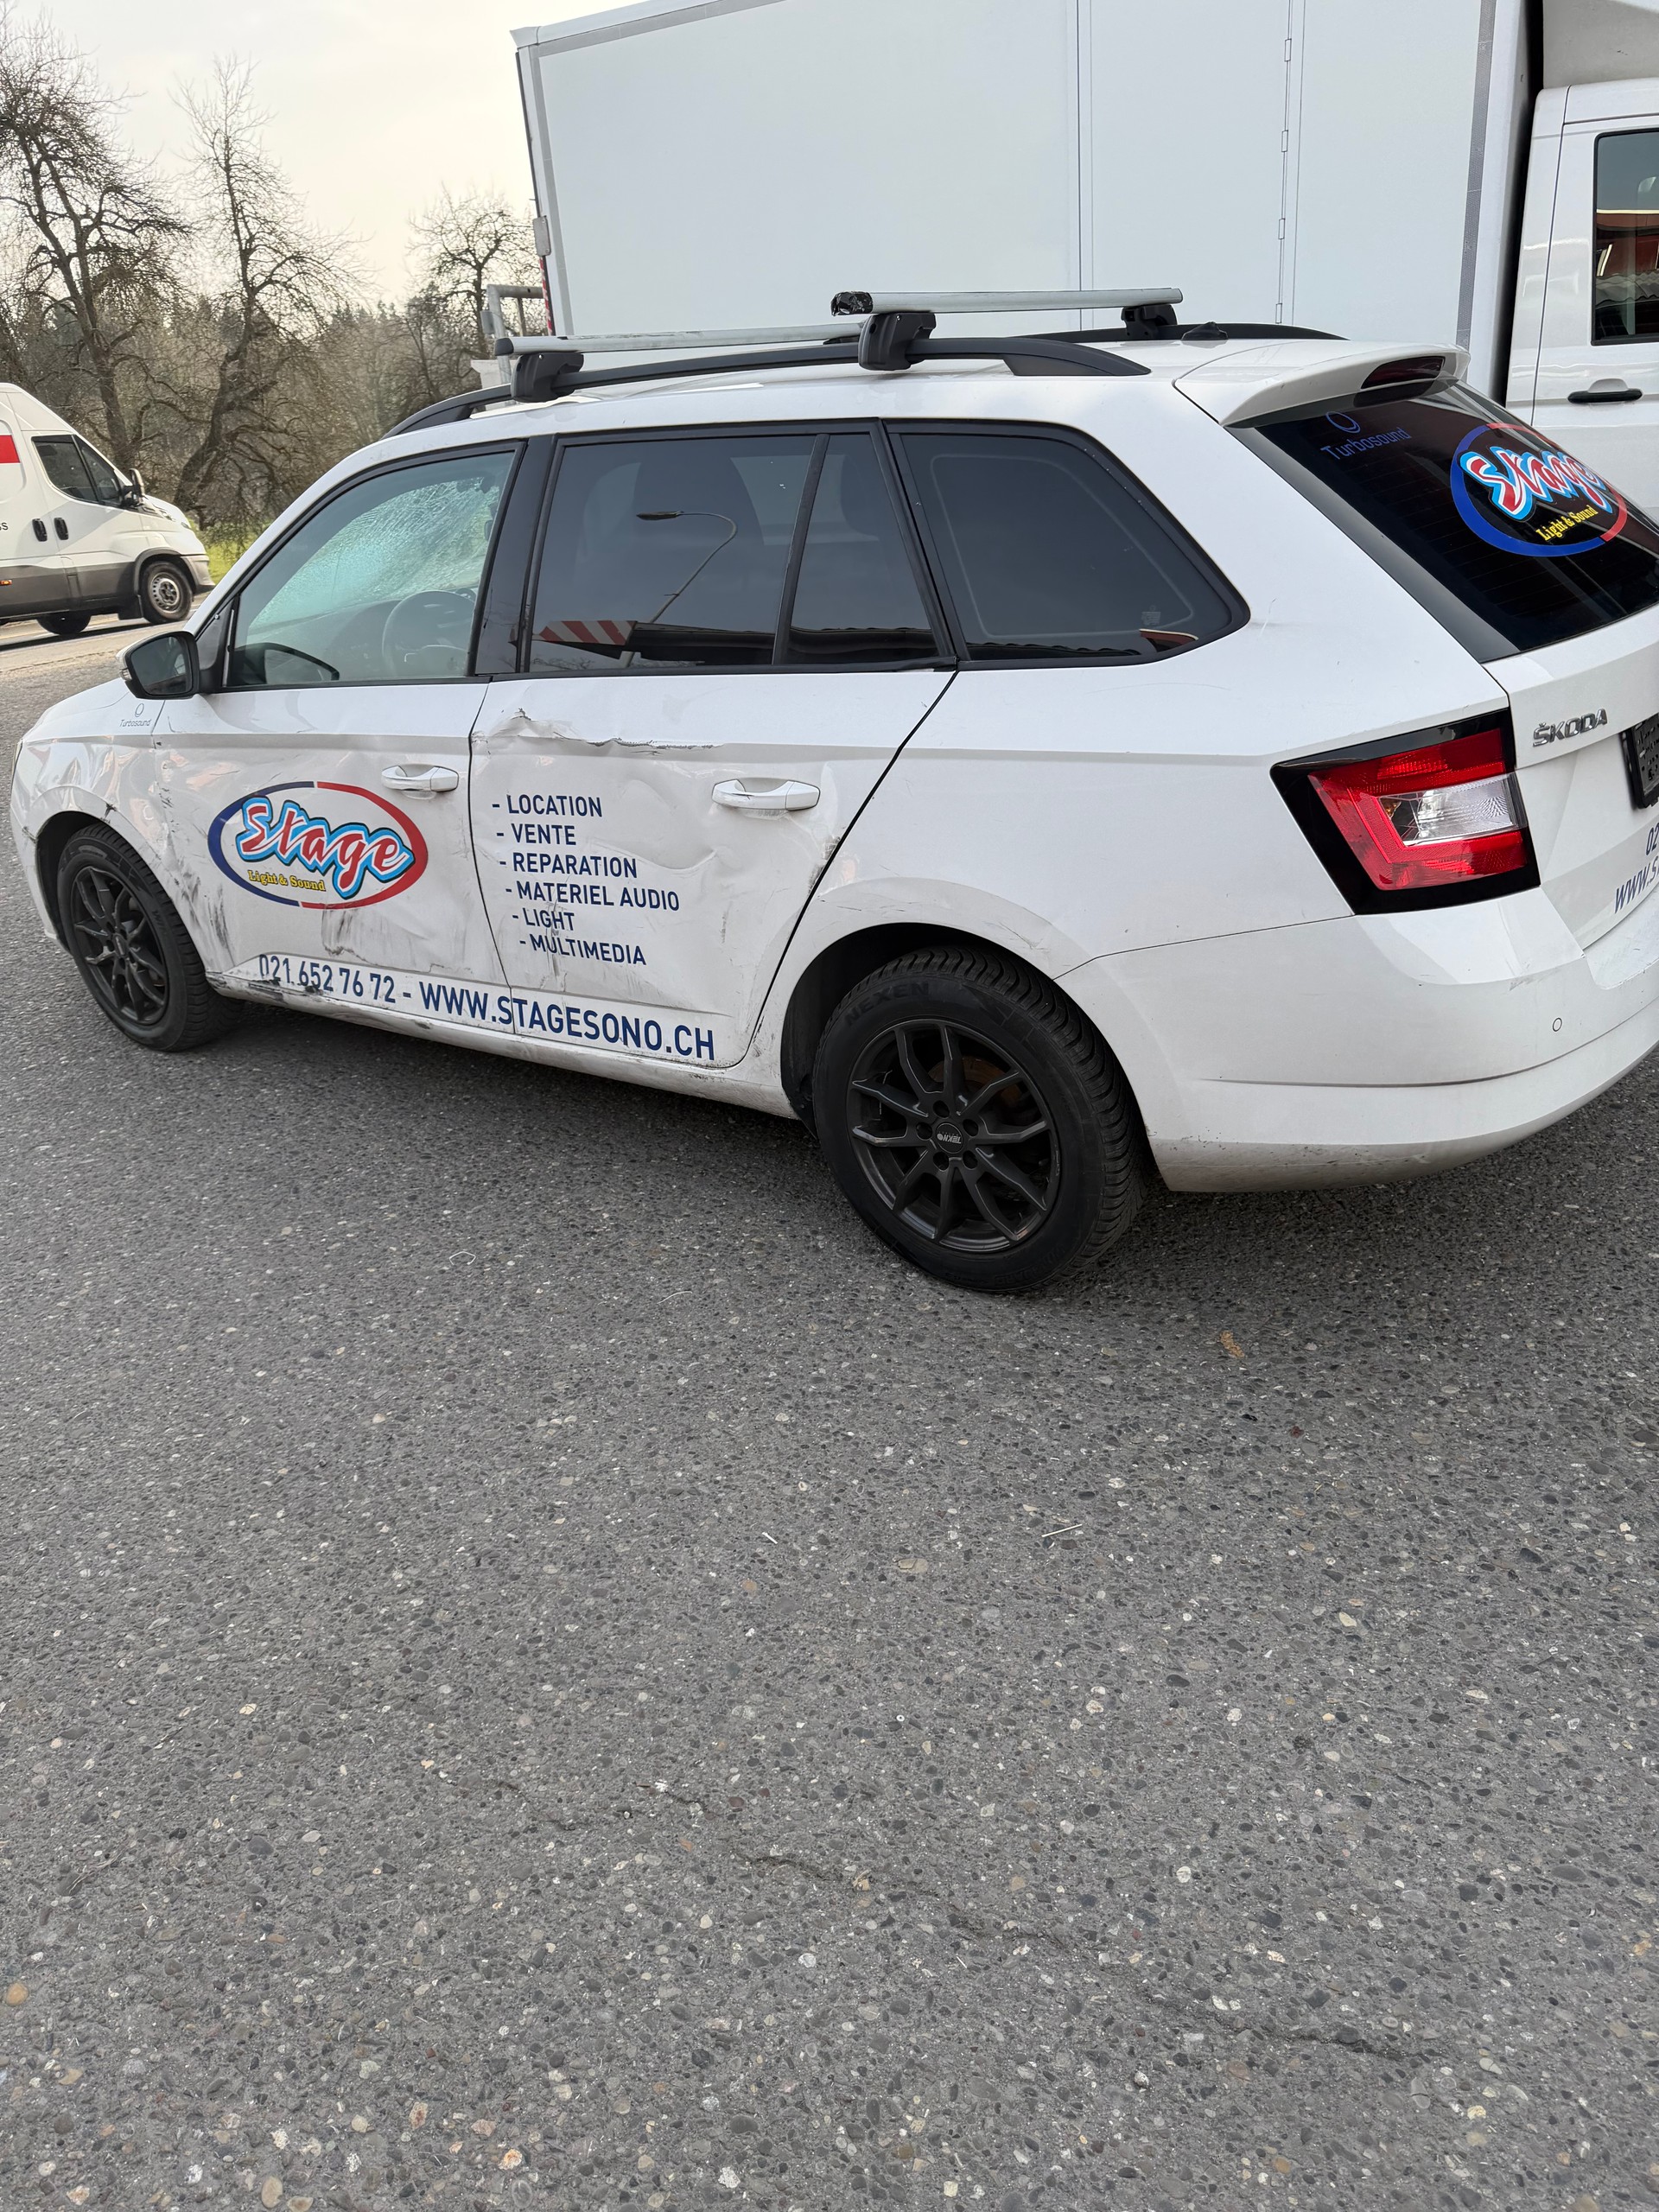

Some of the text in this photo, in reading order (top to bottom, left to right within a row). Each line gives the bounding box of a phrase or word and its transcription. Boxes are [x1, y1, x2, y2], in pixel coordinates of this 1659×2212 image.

[1320, 427, 1413, 461] Turbosound
[1460, 447, 1612, 520] Stage
[1535, 505, 1599, 541] Light & Sound
[120, 718, 152, 728] Turbosound
[1533, 709, 1607, 747] ŠKODA
[507, 794, 602, 817] LOCATION
[236, 797, 415, 898] Stage
[511, 823, 577, 846] VENTE
[247, 869, 327, 892] Light & Sound
[512, 852, 638, 879] REPARATION
[516, 880, 614, 906] MATERIEL
[620, 887, 680, 912] AUDIO
[1614, 855, 1659, 914] WWW.S
[522, 907, 575, 931] LIGHT
[529, 933, 647, 966] MULTIMEDIA
[299, 961, 334, 993] 652
[339, 967, 364, 997] 76
[370, 972, 397, 1004] 72
[418, 981, 716, 1061] WWW.STAGESONO.CH
[844, 981, 930, 1027] NEXEN
